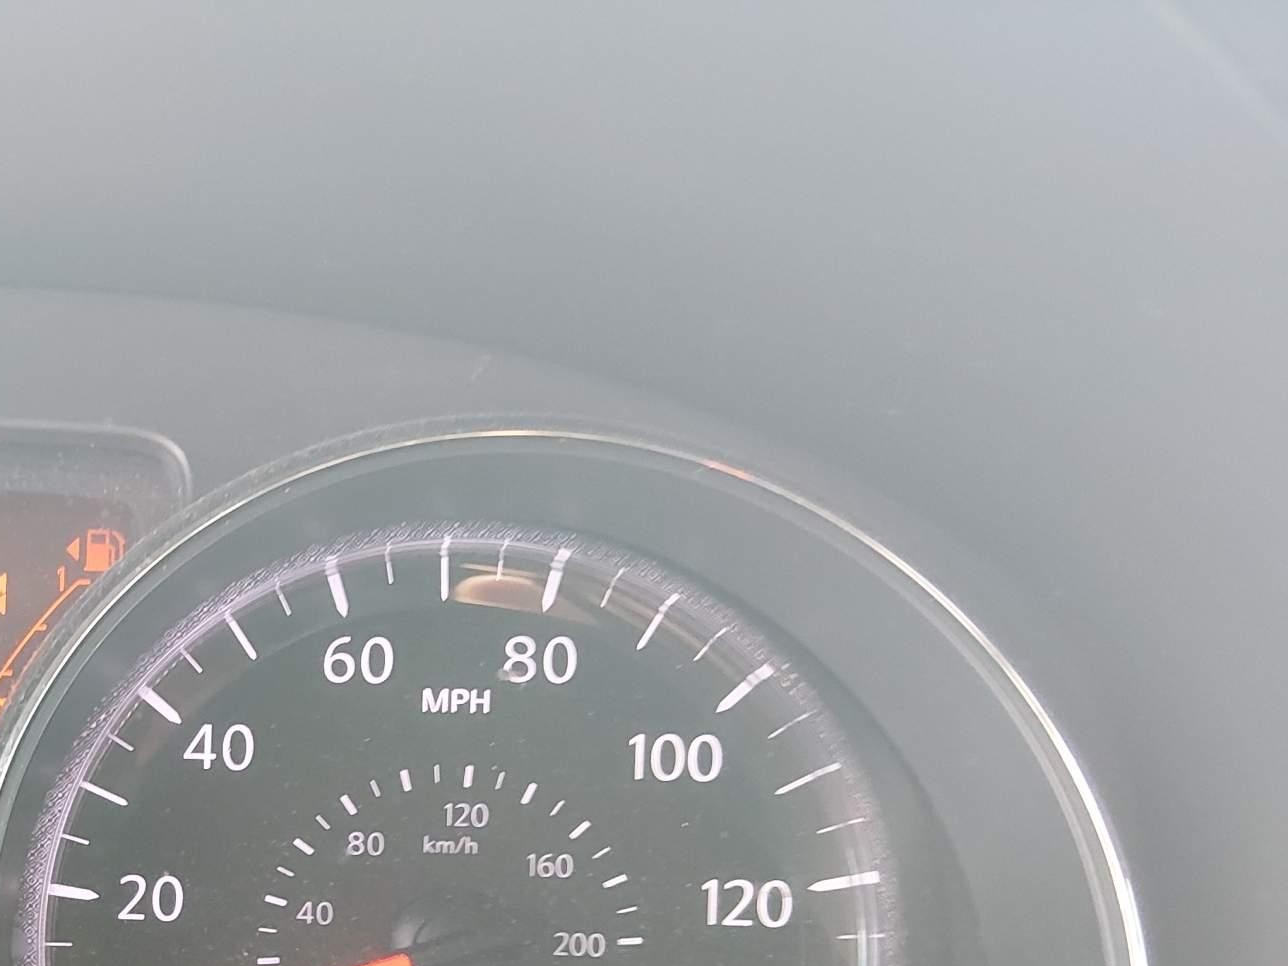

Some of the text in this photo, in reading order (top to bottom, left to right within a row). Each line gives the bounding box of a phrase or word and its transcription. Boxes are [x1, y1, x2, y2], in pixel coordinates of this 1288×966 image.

[56, 565, 67, 593] 1
[322, 637, 394, 685] 60
[503, 637, 578, 686] 80
[421, 688, 492, 714] MPH
[183, 723, 255, 771] 40
[627, 733, 723, 783] 100
[443, 802, 490, 829] 120
[347, 831, 385, 856] 80
[422, 835, 479, 855] km/h
[526, 852, 574, 879] 160
[117, 874, 184, 922] 20
[700, 879, 793, 929] 120
[296, 901, 334, 925] 40
[552, 932, 606, 957] 200
